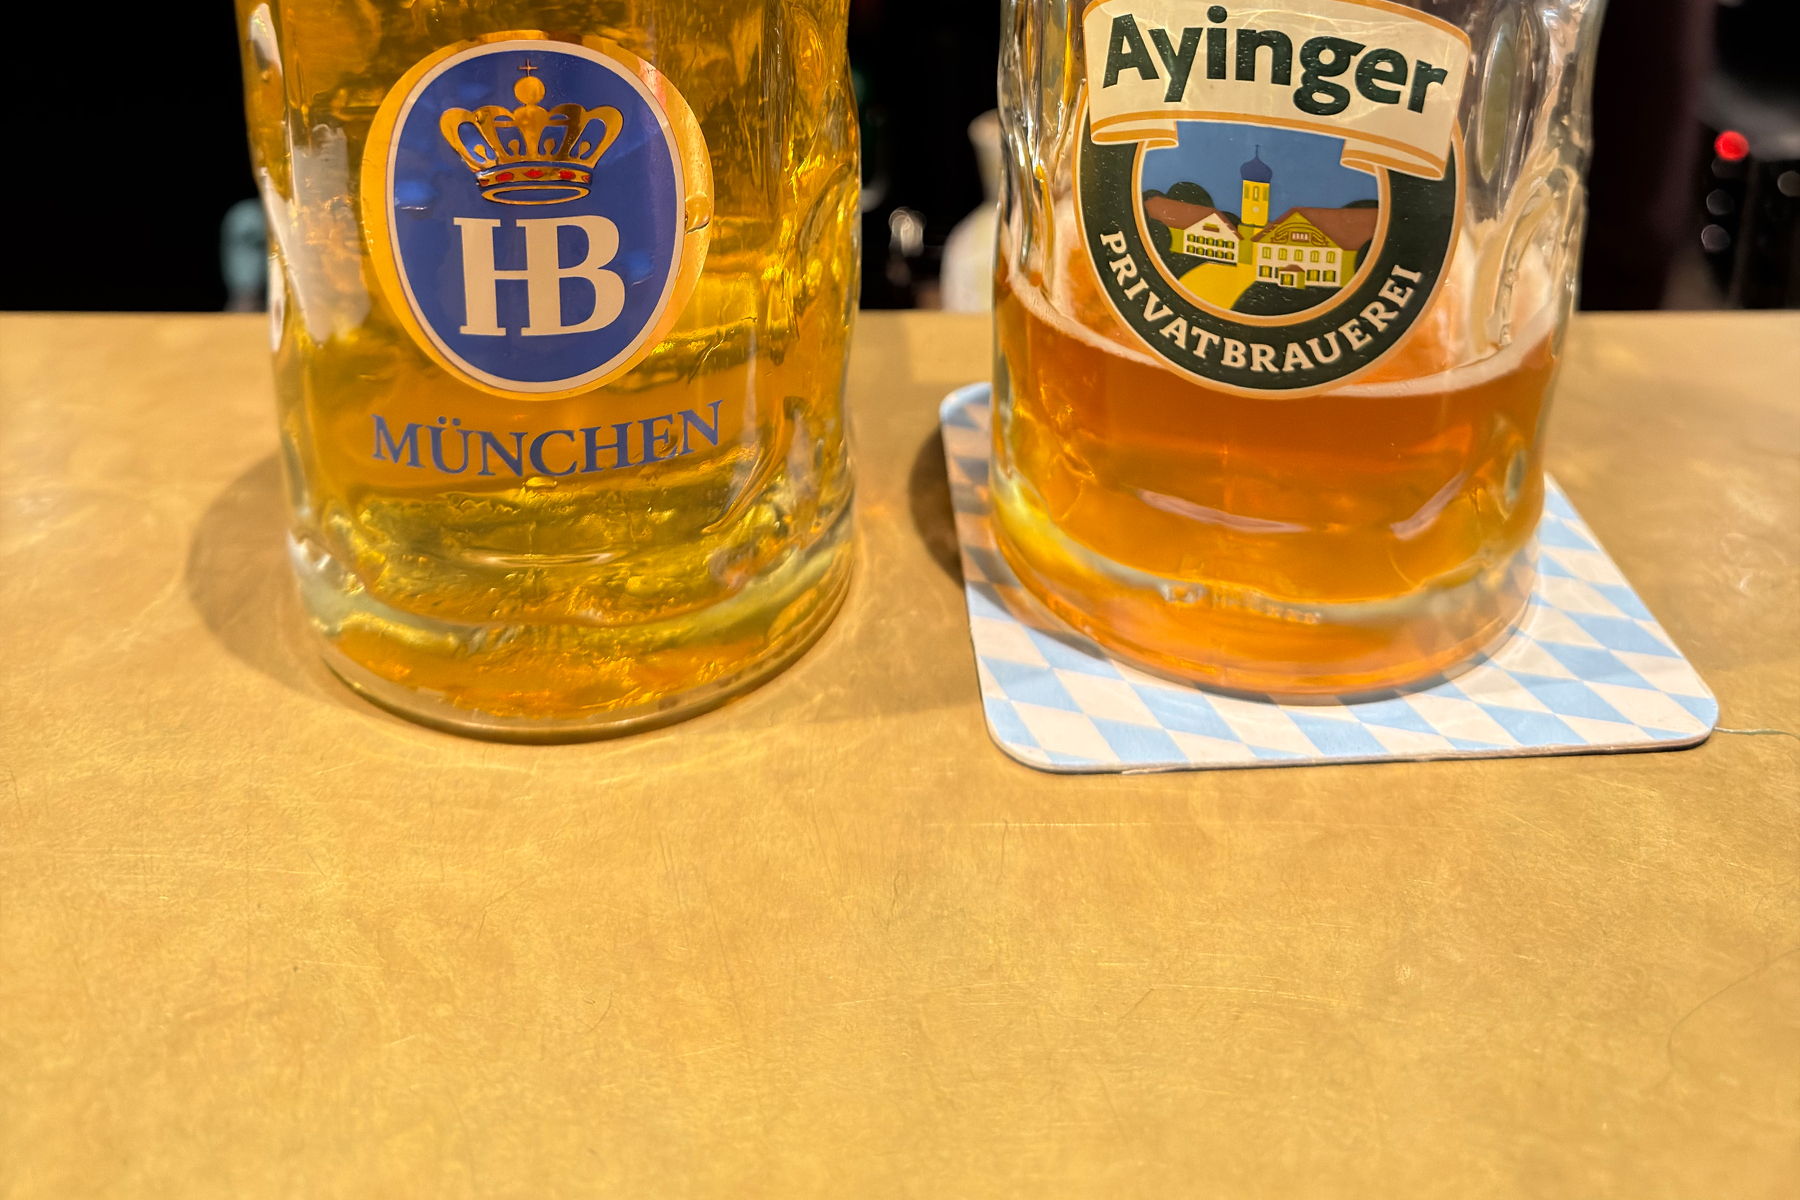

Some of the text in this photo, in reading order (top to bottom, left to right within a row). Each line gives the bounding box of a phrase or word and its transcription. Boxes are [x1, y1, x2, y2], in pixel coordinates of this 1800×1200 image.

[1102, 5, 1449, 116] Ayinger
[453, 214, 626, 338] HB
[1100, 230, 1422, 373] PRIVATBRAUEREI
[371, 400, 724, 478] MÜNCHEN
